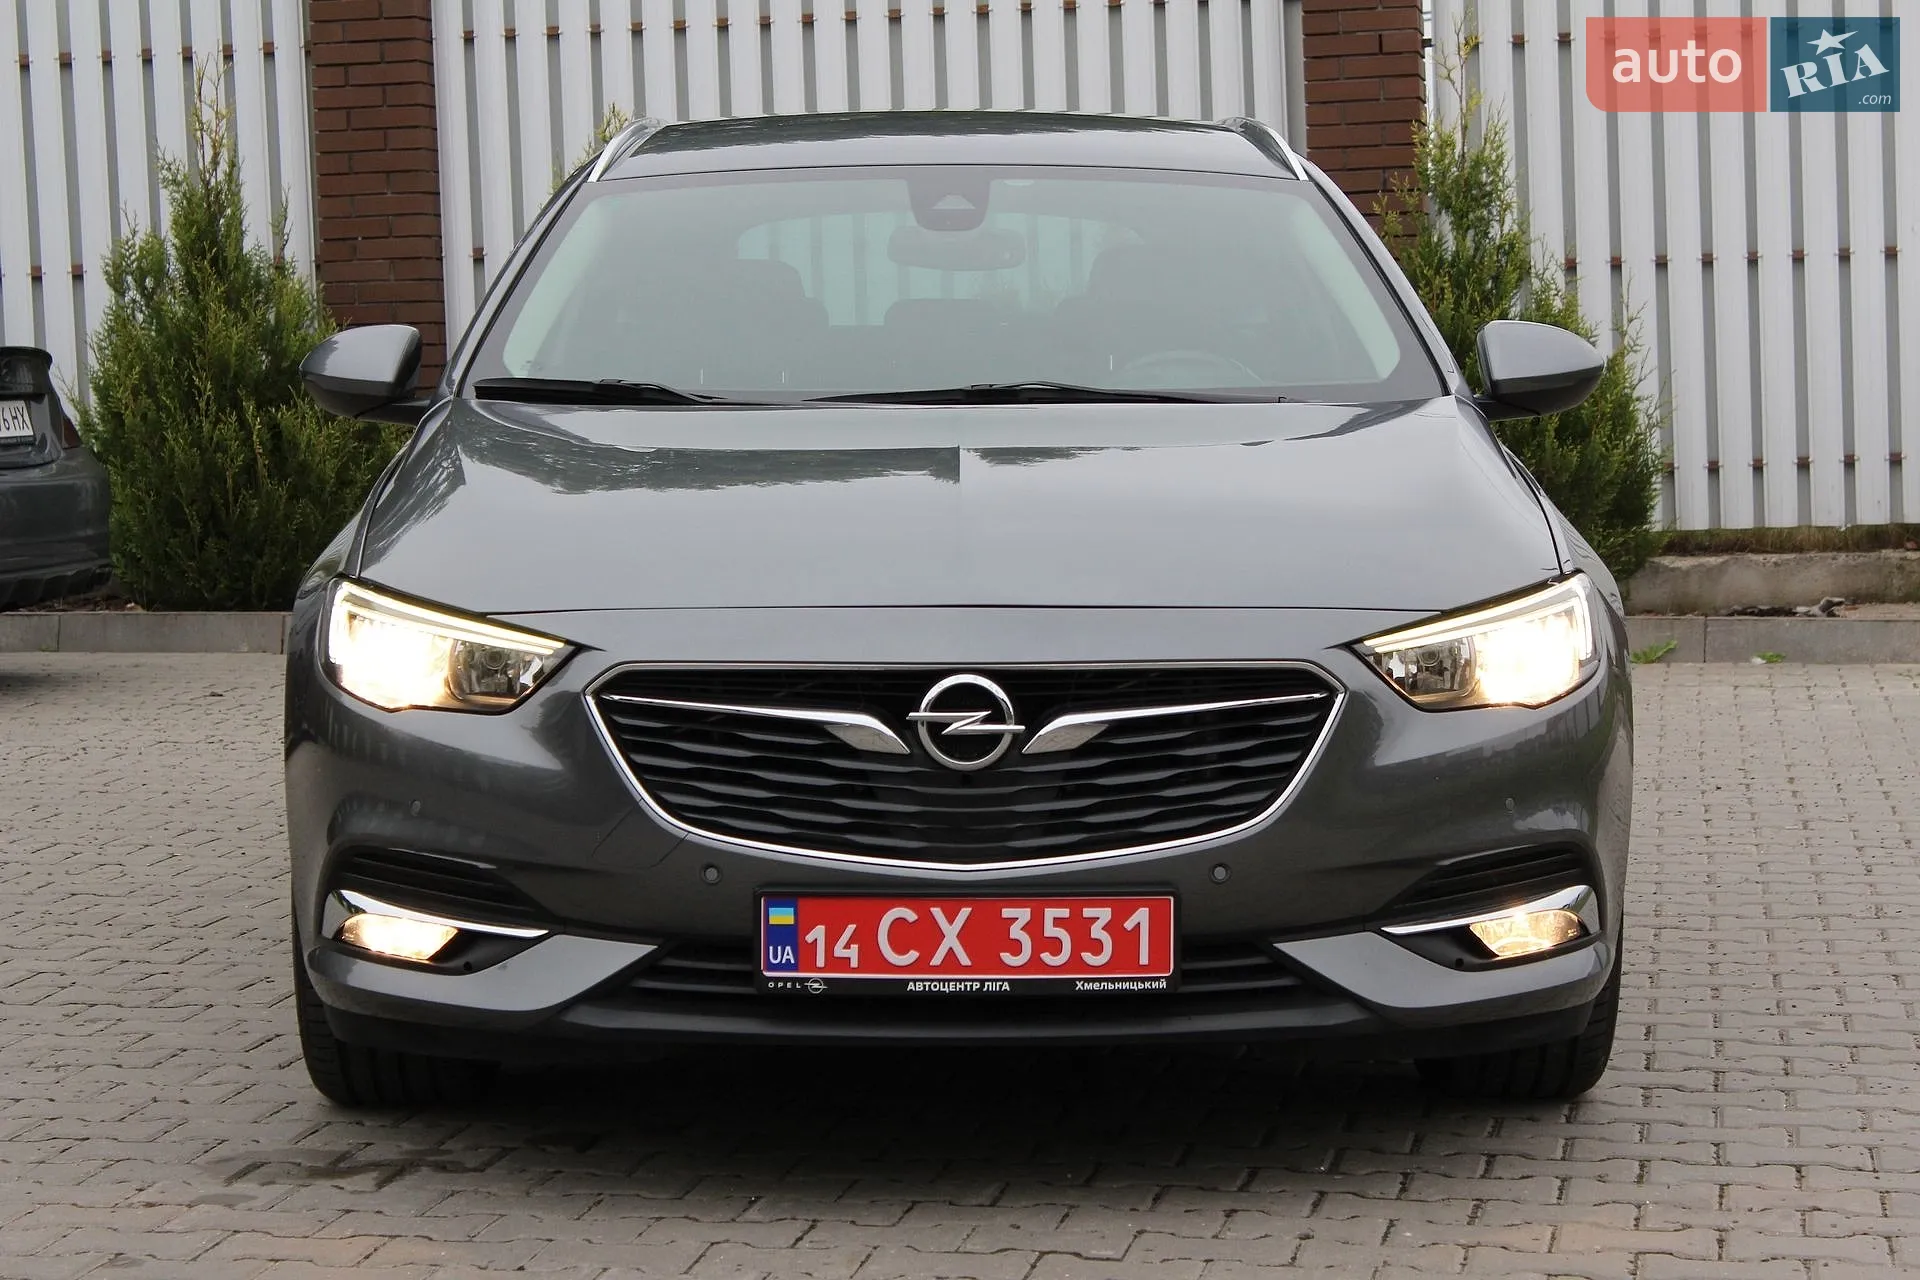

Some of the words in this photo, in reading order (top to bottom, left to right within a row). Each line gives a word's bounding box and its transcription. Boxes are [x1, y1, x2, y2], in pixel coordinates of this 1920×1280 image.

[805, 924, 859, 968] 14
[1000, 907, 1150, 967] 3531
[769, 946, 795, 964] UA
[907, 981, 980, 993] АВТОЦЕНТР
[983, 981, 1010, 992] ЛІГА
[1075, 979, 1167, 991] Хмельницький
